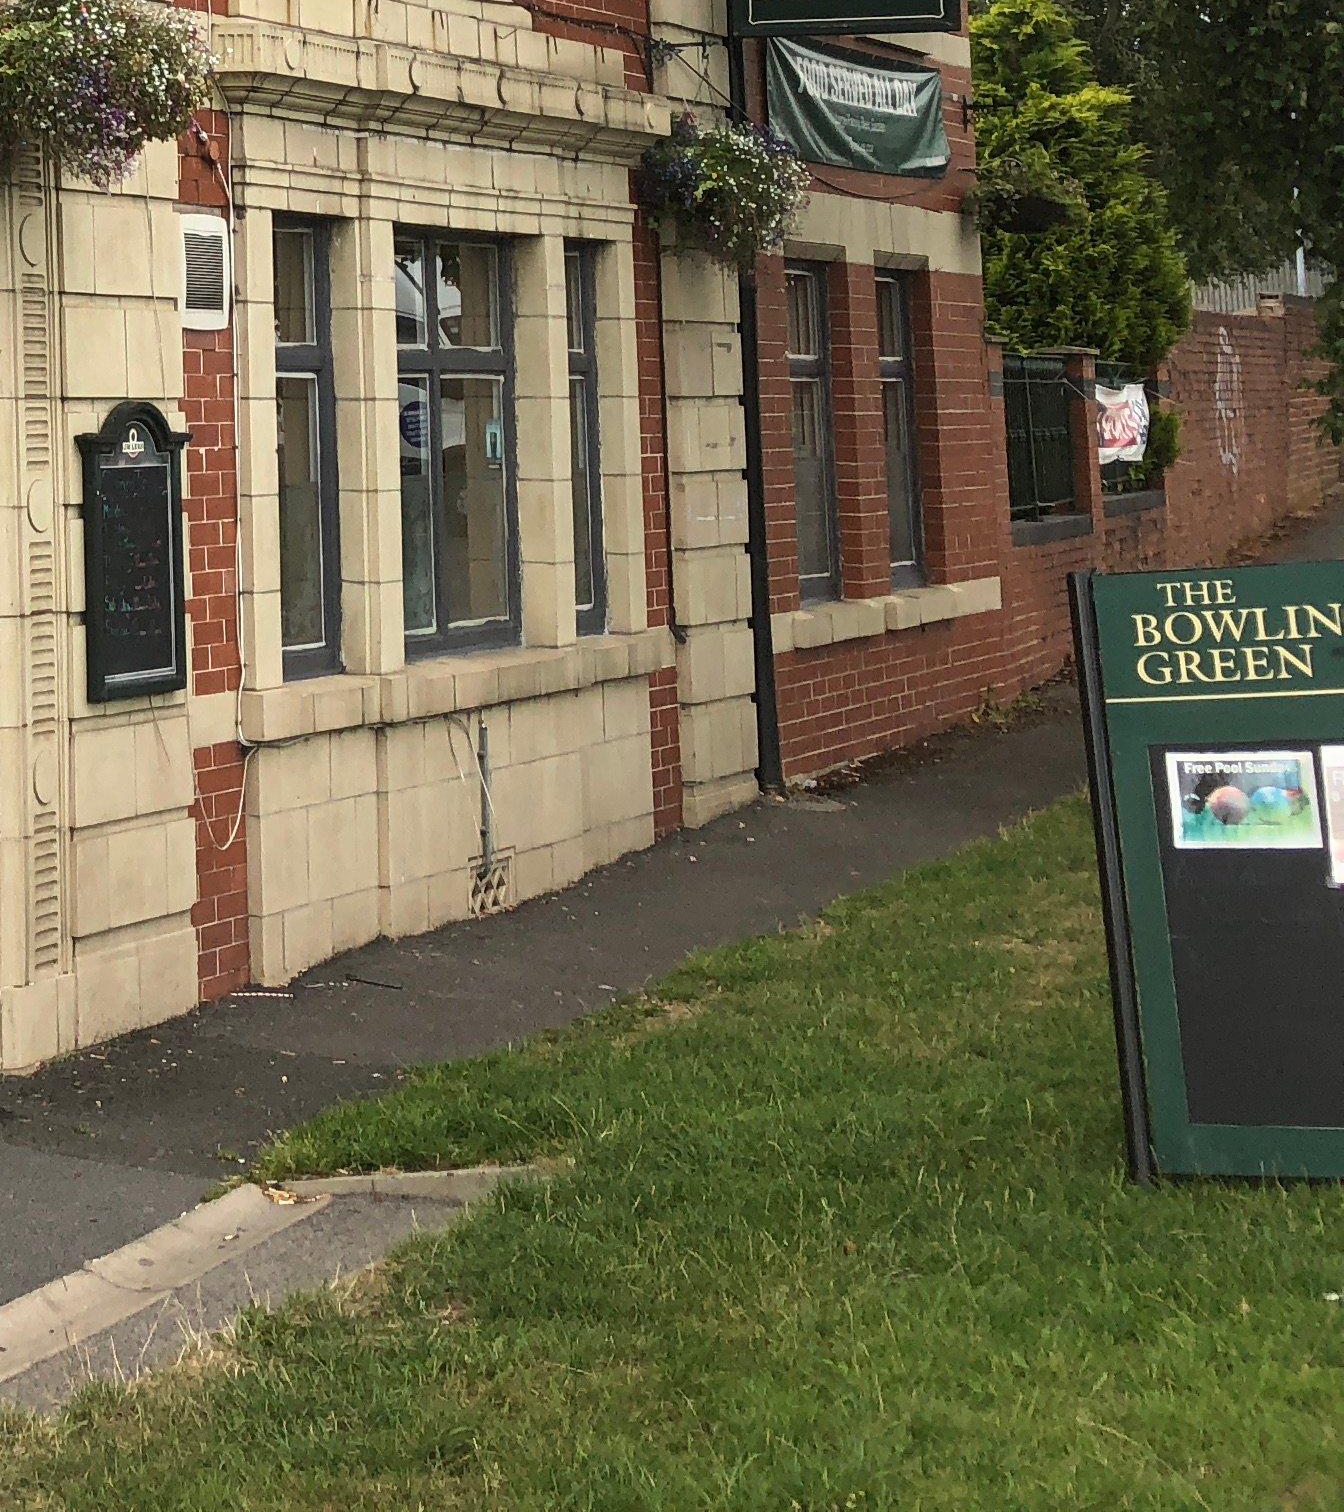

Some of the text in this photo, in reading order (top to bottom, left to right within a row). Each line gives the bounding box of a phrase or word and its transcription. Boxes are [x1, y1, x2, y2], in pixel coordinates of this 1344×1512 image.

[1156, 579, 1237, 607] THE
[1131, 603, 1344, 647] BOWLIN
[1136, 644, 1314, 685] GREEN
[1184, 762, 1212, 774] Free
[1214, 762, 1242, 774] Pool
